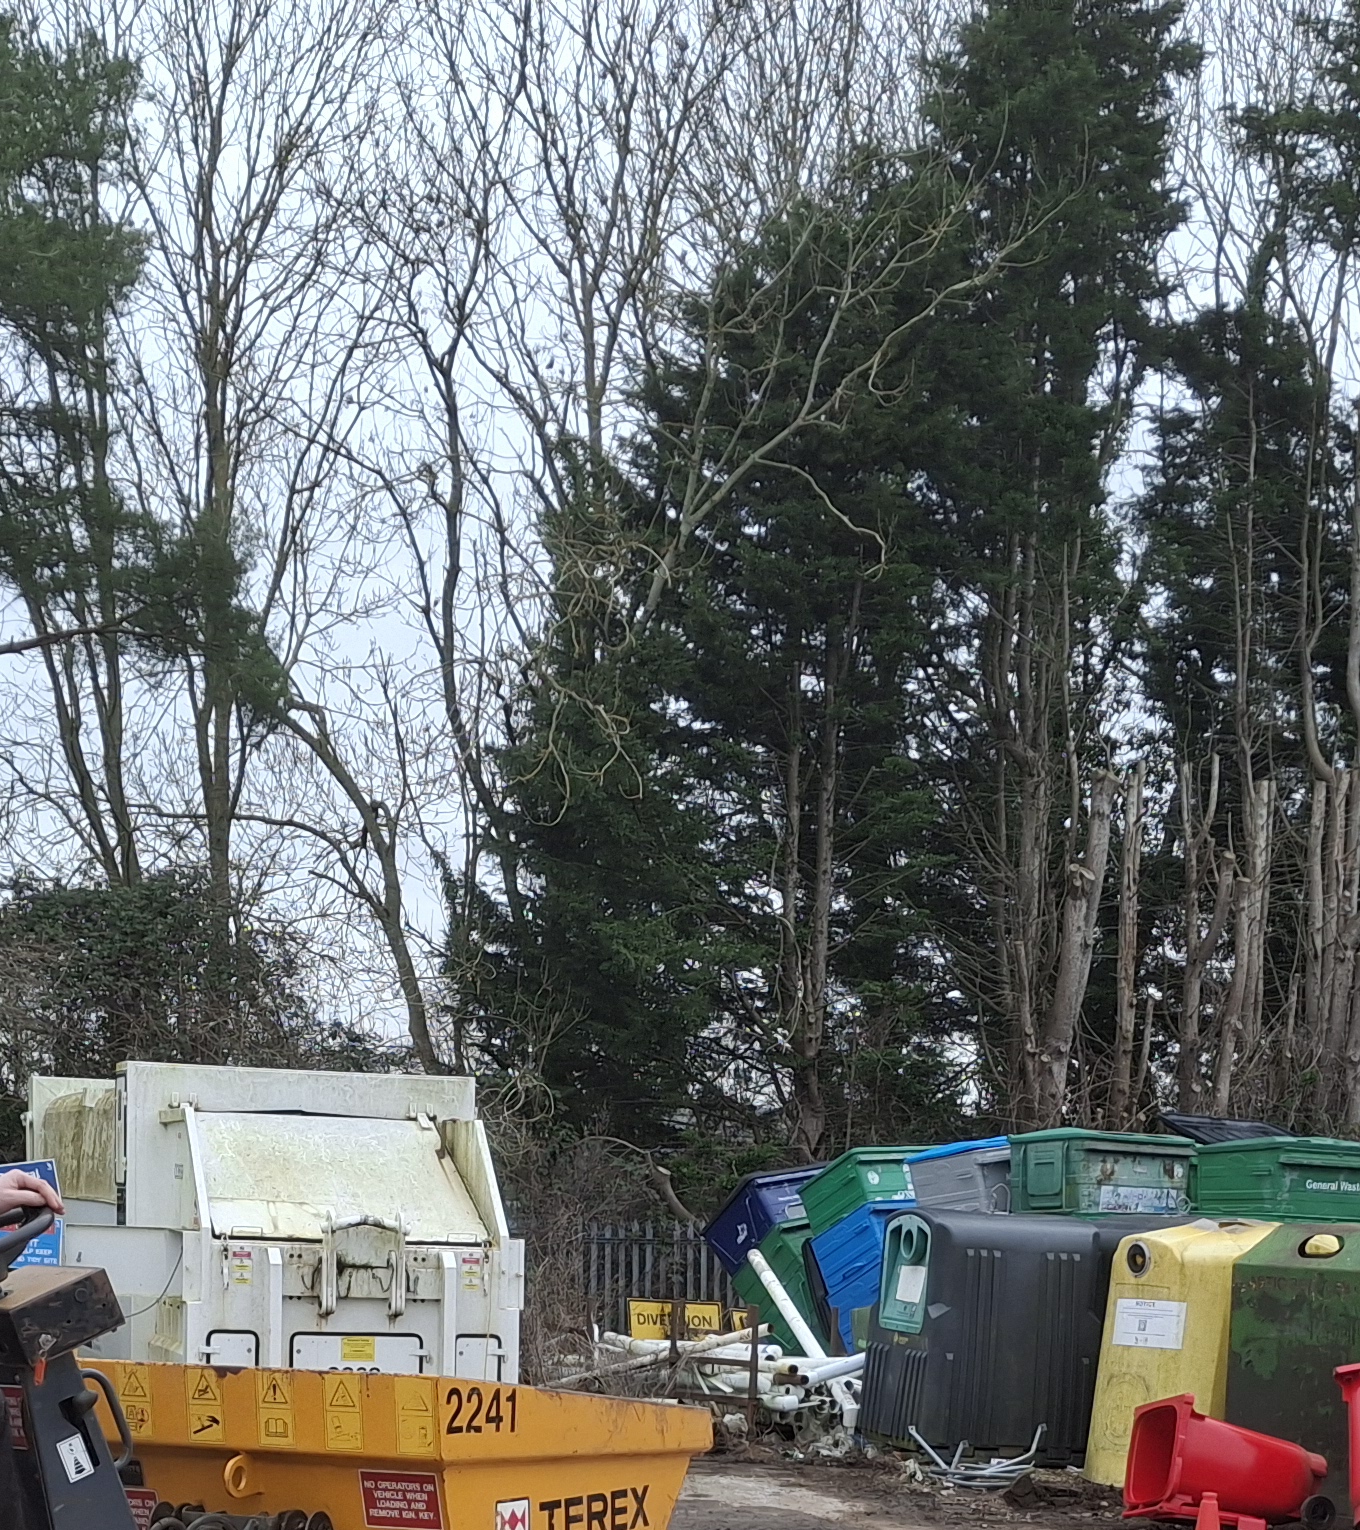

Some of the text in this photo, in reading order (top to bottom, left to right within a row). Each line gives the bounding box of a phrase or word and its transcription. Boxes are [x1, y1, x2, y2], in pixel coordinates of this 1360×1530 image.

[1305, 1179, 1339, 1191] General
[637, 1312, 713, 1328] DIVEION
[445, 1386, 518, 1436] 2241
[363, 1480, 435, 1492] NO OPERATORS ON
[372, 1490, 428, 1501] VEHICLE WHEN
[376, 1500, 427, 1510] LOADING AND
[369, 1509, 400, 1518] REMOVE
